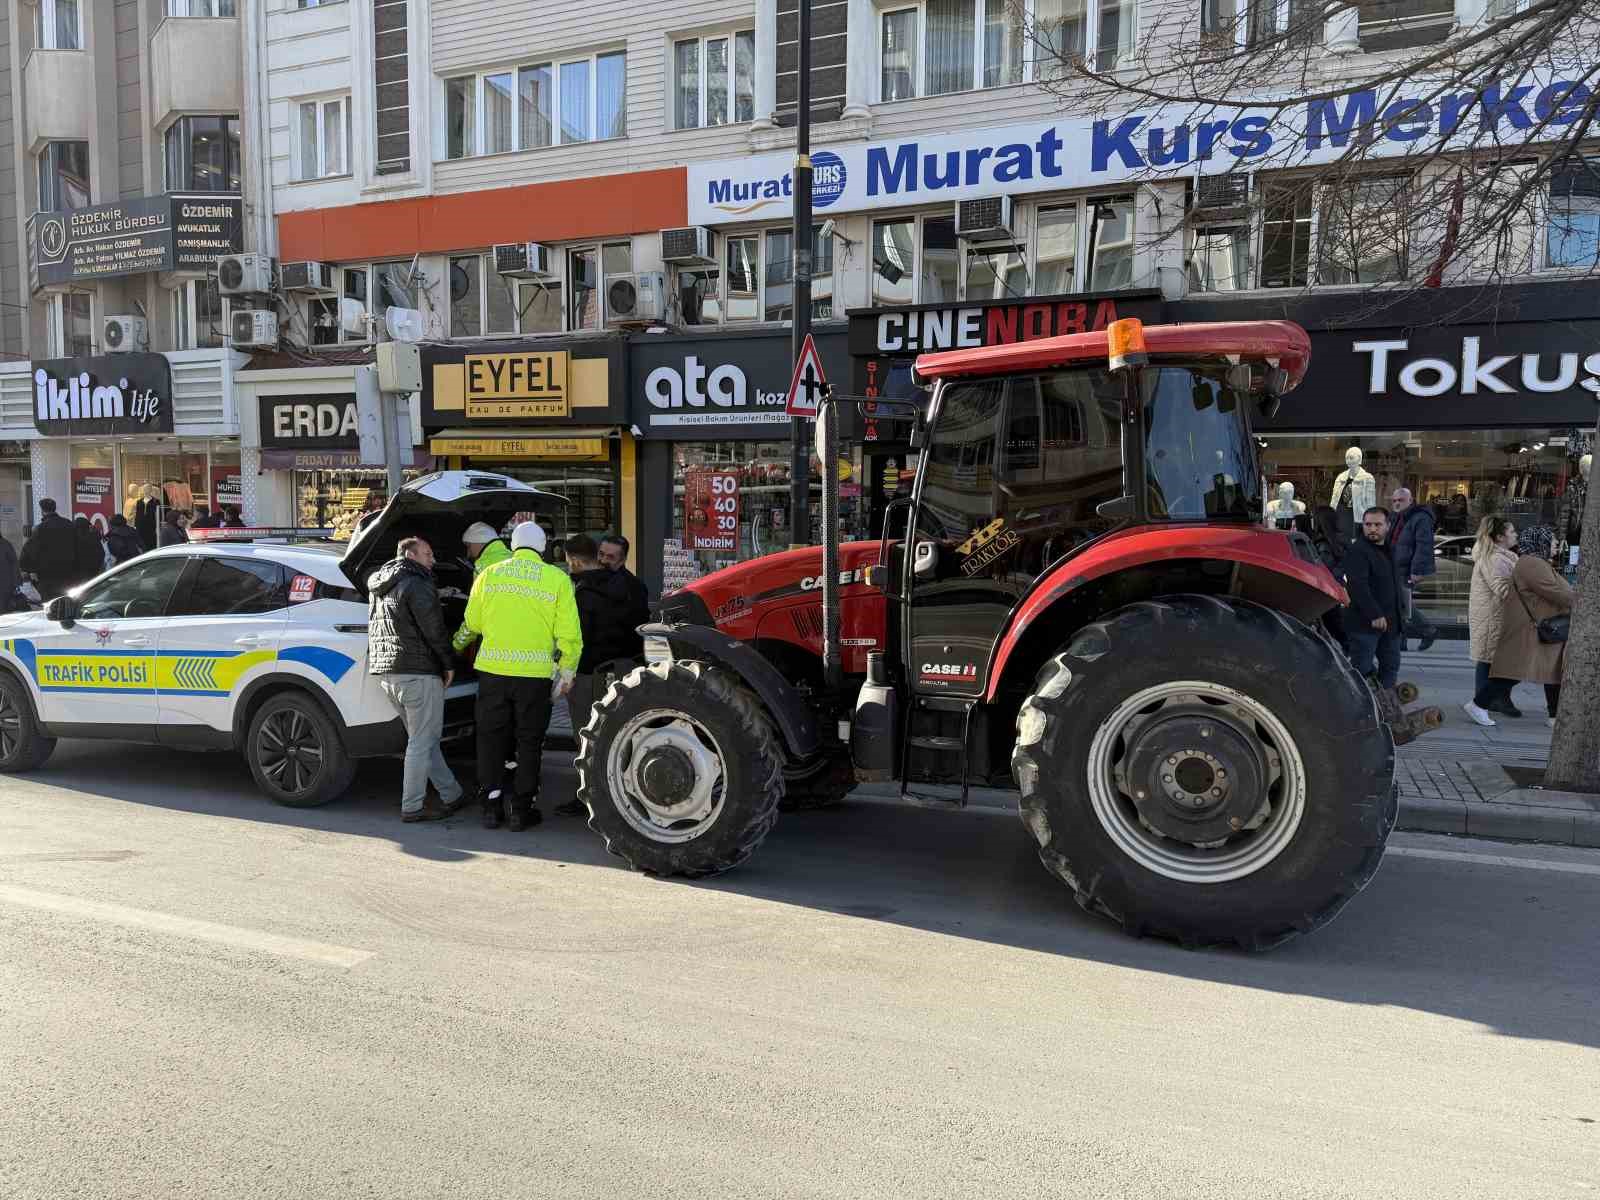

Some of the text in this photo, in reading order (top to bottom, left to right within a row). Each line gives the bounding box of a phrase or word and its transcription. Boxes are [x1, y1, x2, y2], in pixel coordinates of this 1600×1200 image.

[866, 74, 1600, 197] Murat Kurs Merke
[811, 164, 841, 185] URS
[708, 173, 793, 204] Murat
[71, 207, 121, 226] ÖZDEMİR
[182, 203, 233, 219] ÖZDEMİR
[72, 214, 165, 238] HUKUK BÜROSU
[177, 224, 221, 233] AVUKATLIK
[177, 239, 231, 249] DANIŞMANLIK
[469, 356, 562, 393] EYFEL
[645, 355, 791, 408] ata koz
[130, 389, 160, 423] life
[470, 406, 489, 414] EAU
[520, 405, 564, 413] PARFUM
[501, 442, 525, 451] EYFEL
[296, 455, 333, 466] ERDAYI
[712, 476, 736, 494] 50
[714, 497, 736, 513] 40
[718, 516, 736, 529] 30
[694, 535, 734, 548] İNDİRİM
[295, 578, 313, 591] 112
[44, 661, 147, 682] TRAFİK POLİSİ
[921, 663, 961, 675] CASE
